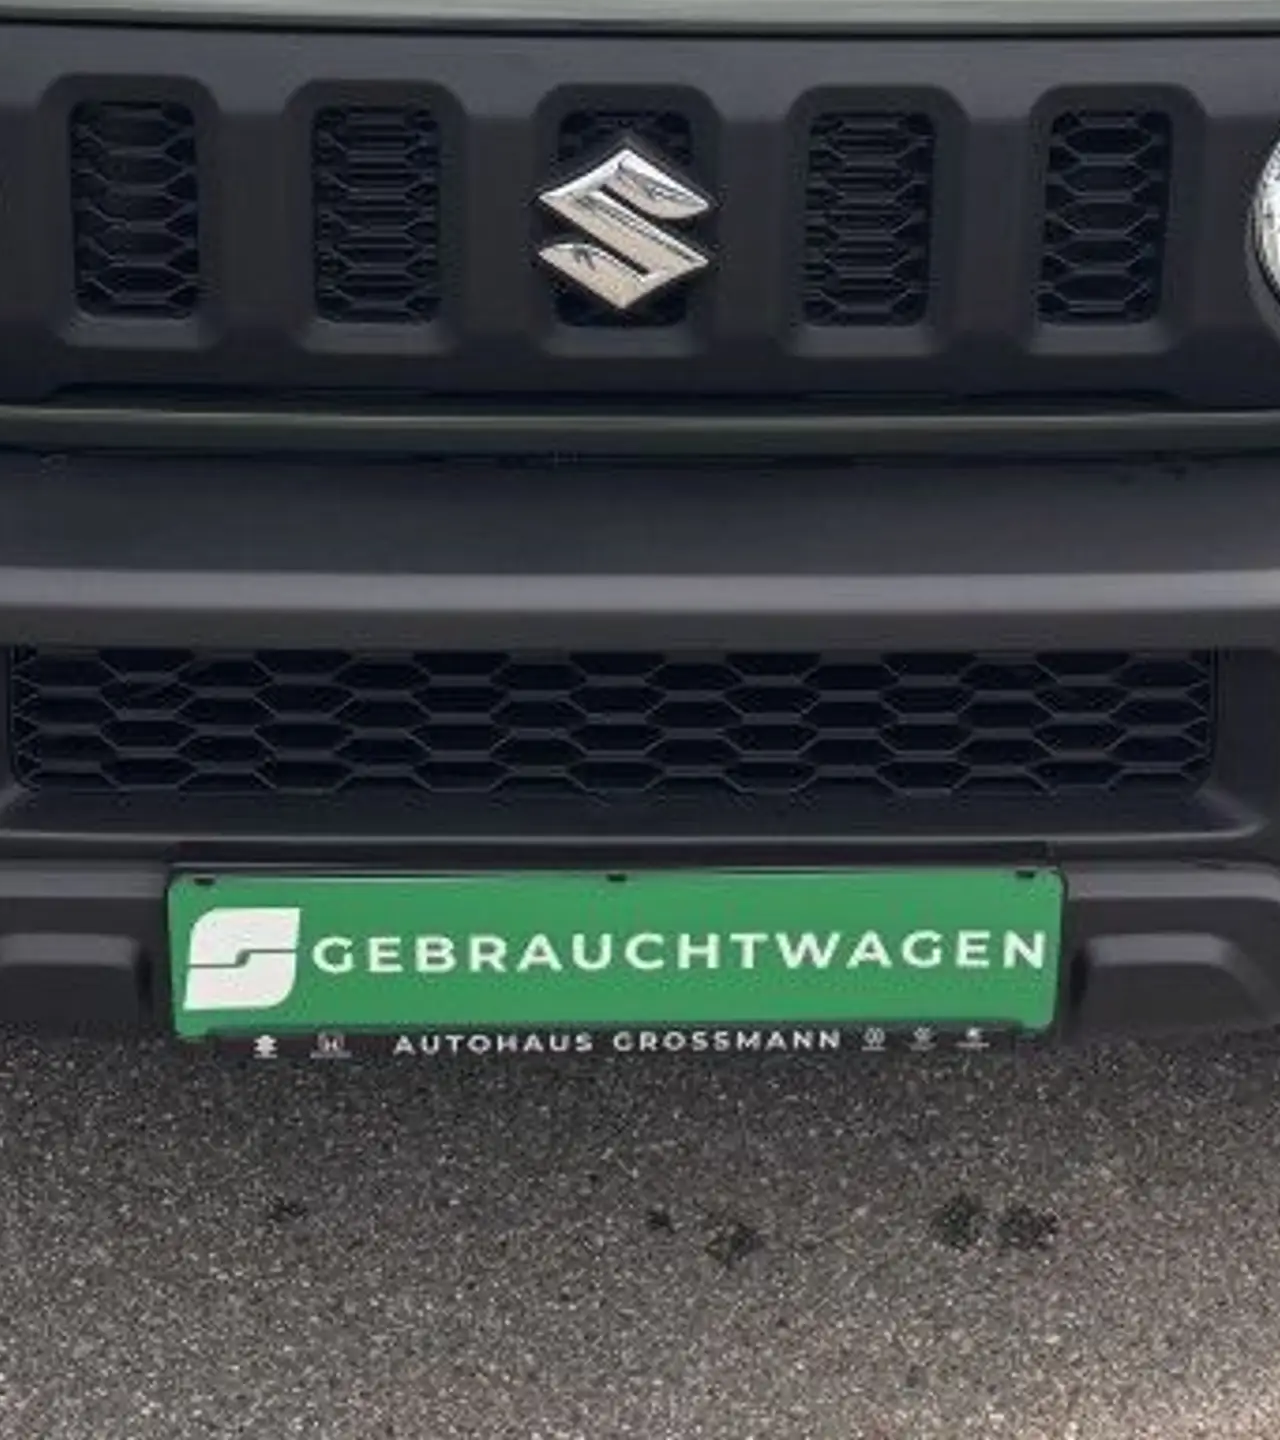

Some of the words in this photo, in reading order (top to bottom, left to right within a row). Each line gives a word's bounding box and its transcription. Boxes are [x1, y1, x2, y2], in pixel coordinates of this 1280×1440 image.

[312, 929, 1046, 974] GEBRAUCHTWAGEN
[392, 1032, 595, 1056] AUTOHAUS
[612, 1029, 842, 1052] GROSSMANN
